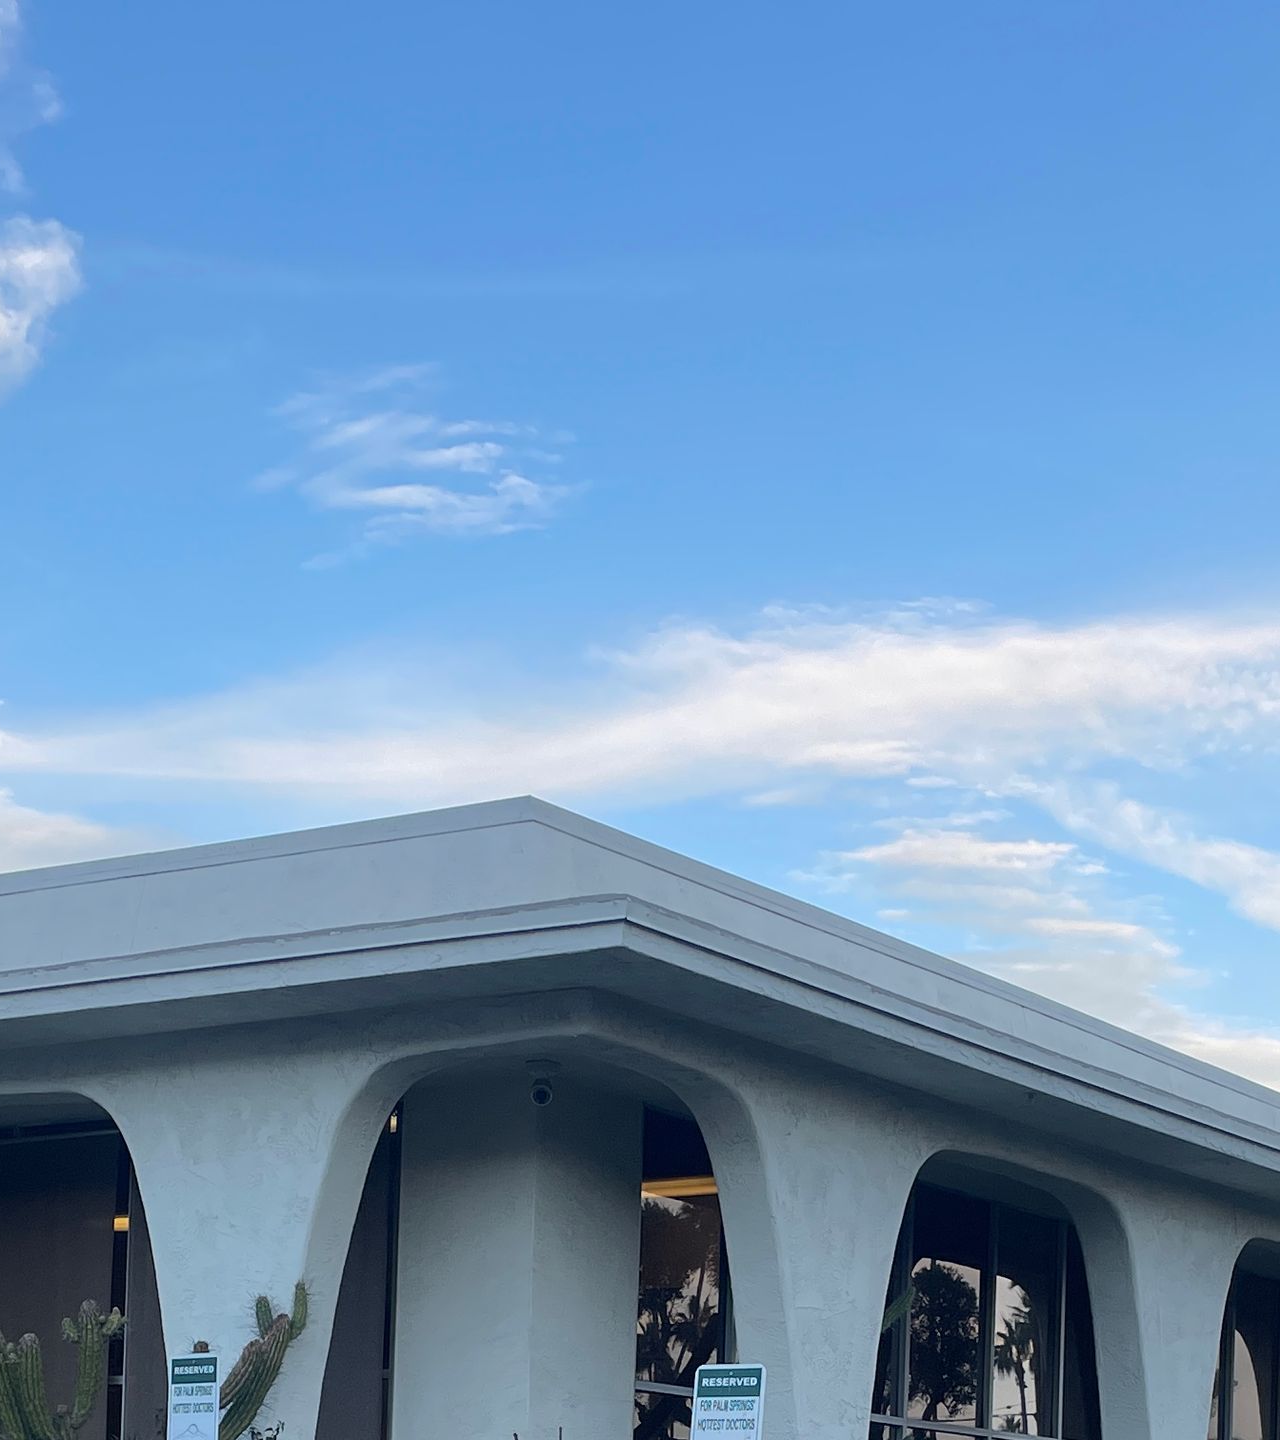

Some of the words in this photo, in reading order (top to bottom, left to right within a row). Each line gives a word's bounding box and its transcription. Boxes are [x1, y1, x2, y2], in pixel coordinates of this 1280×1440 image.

[174, 1365, 215, 1375] RESERVED
[701, 1377, 758, 1387] RESERVED
[700, 1400, 712, 1412] FOR
[713, 1400, 729, 1412] PALM
[697, 1418, 725, 1431] HOTTEST
[726, 1418, 755, 1430] DOCTORS
